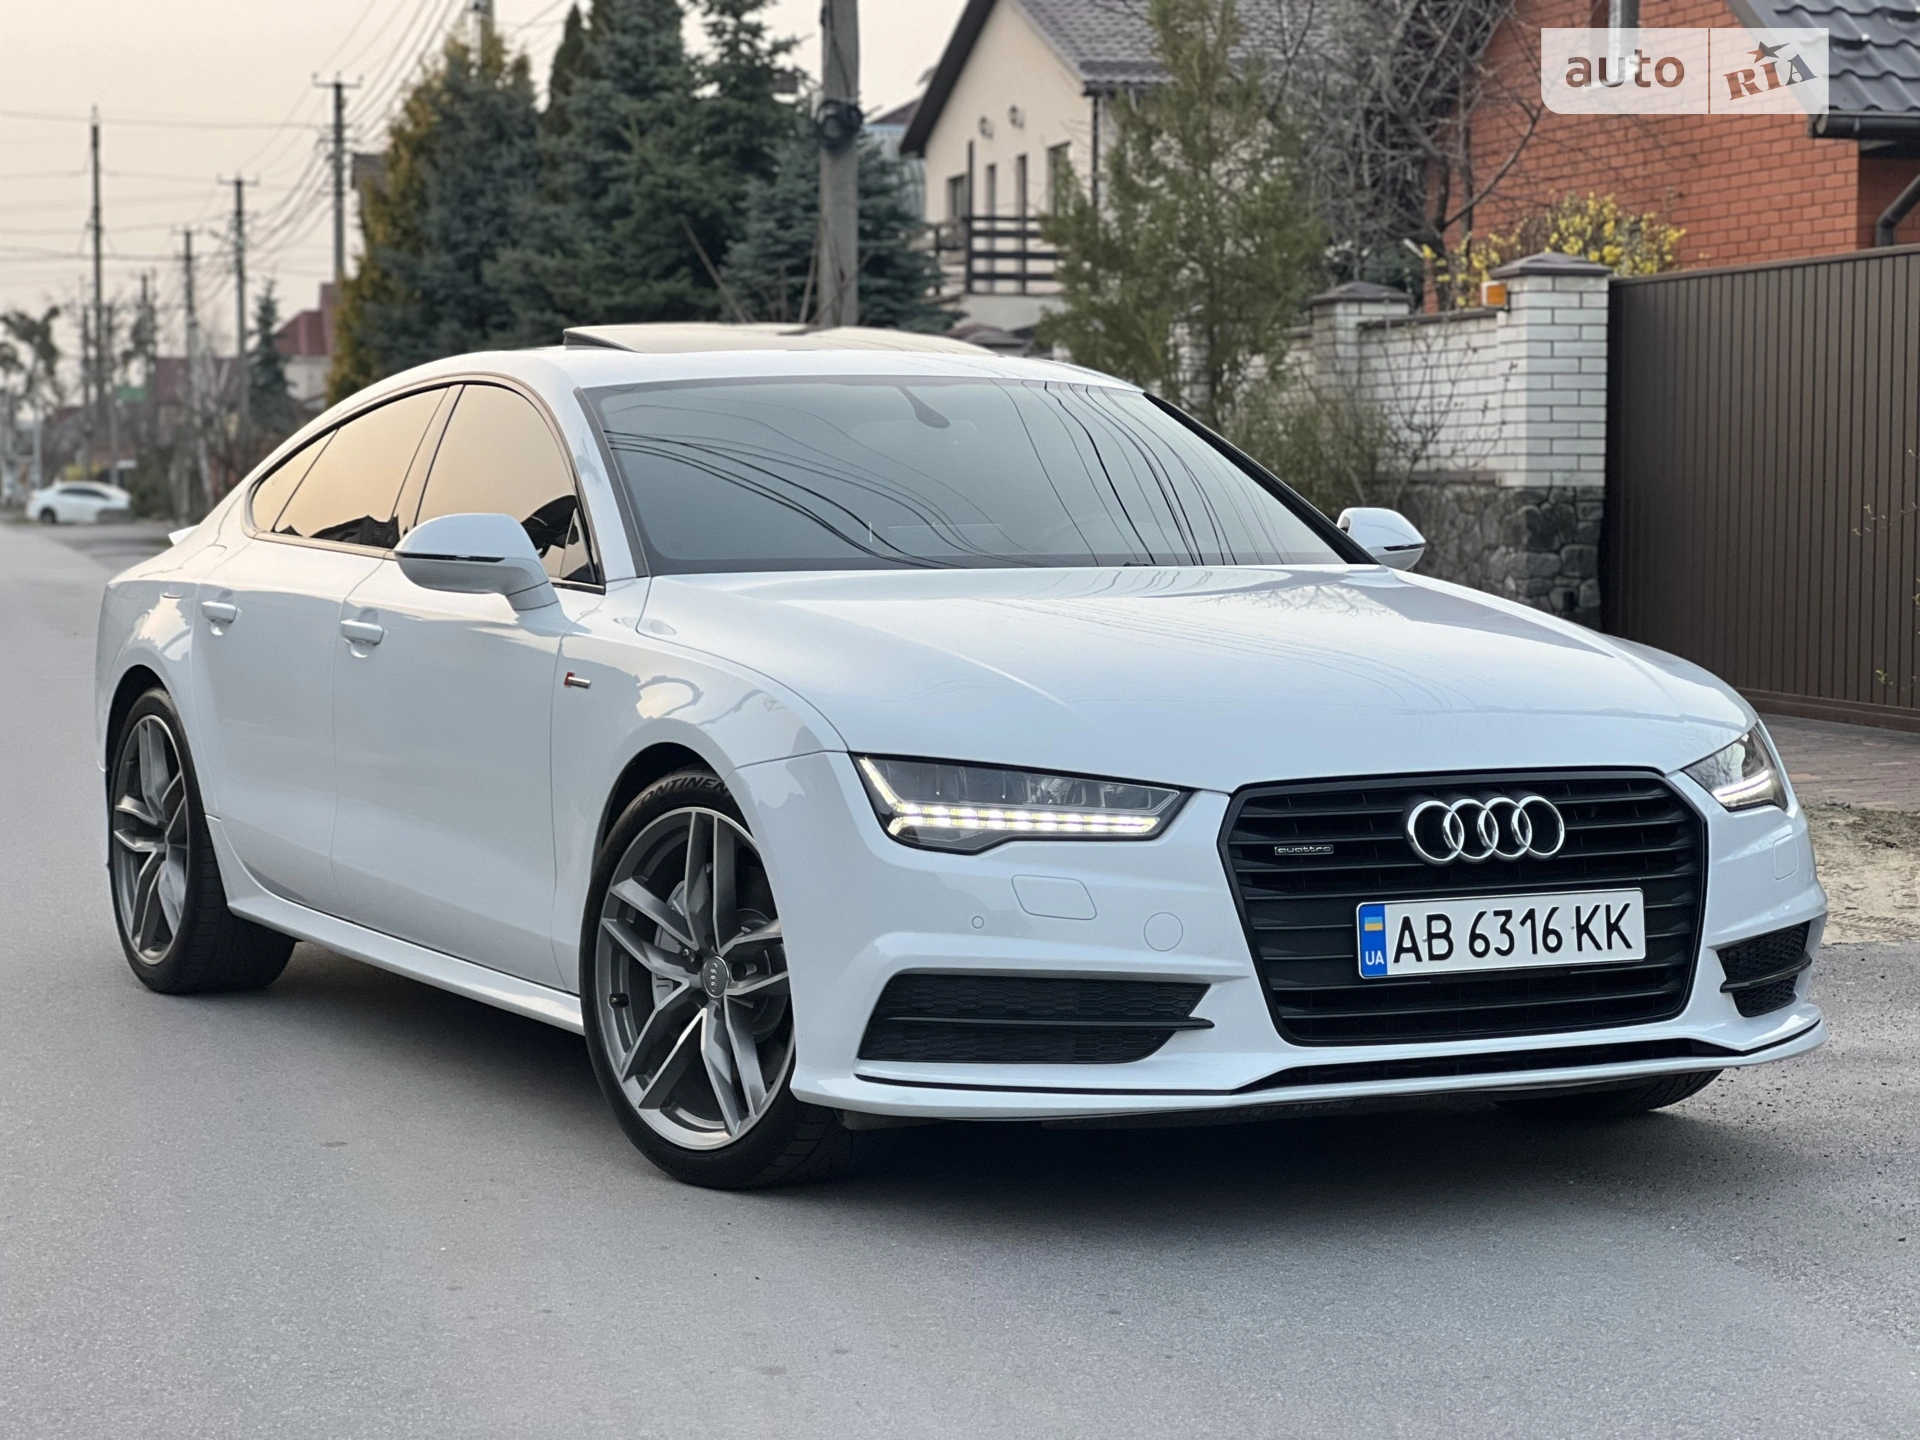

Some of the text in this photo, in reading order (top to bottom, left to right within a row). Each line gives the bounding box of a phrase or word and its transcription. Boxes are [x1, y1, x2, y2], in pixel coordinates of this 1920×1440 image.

[1277, 846, 1331, 855] quattro
[1393, 903, 1633, 963] AB 6316 KK
[1365, 952, 1385, 966] UA
